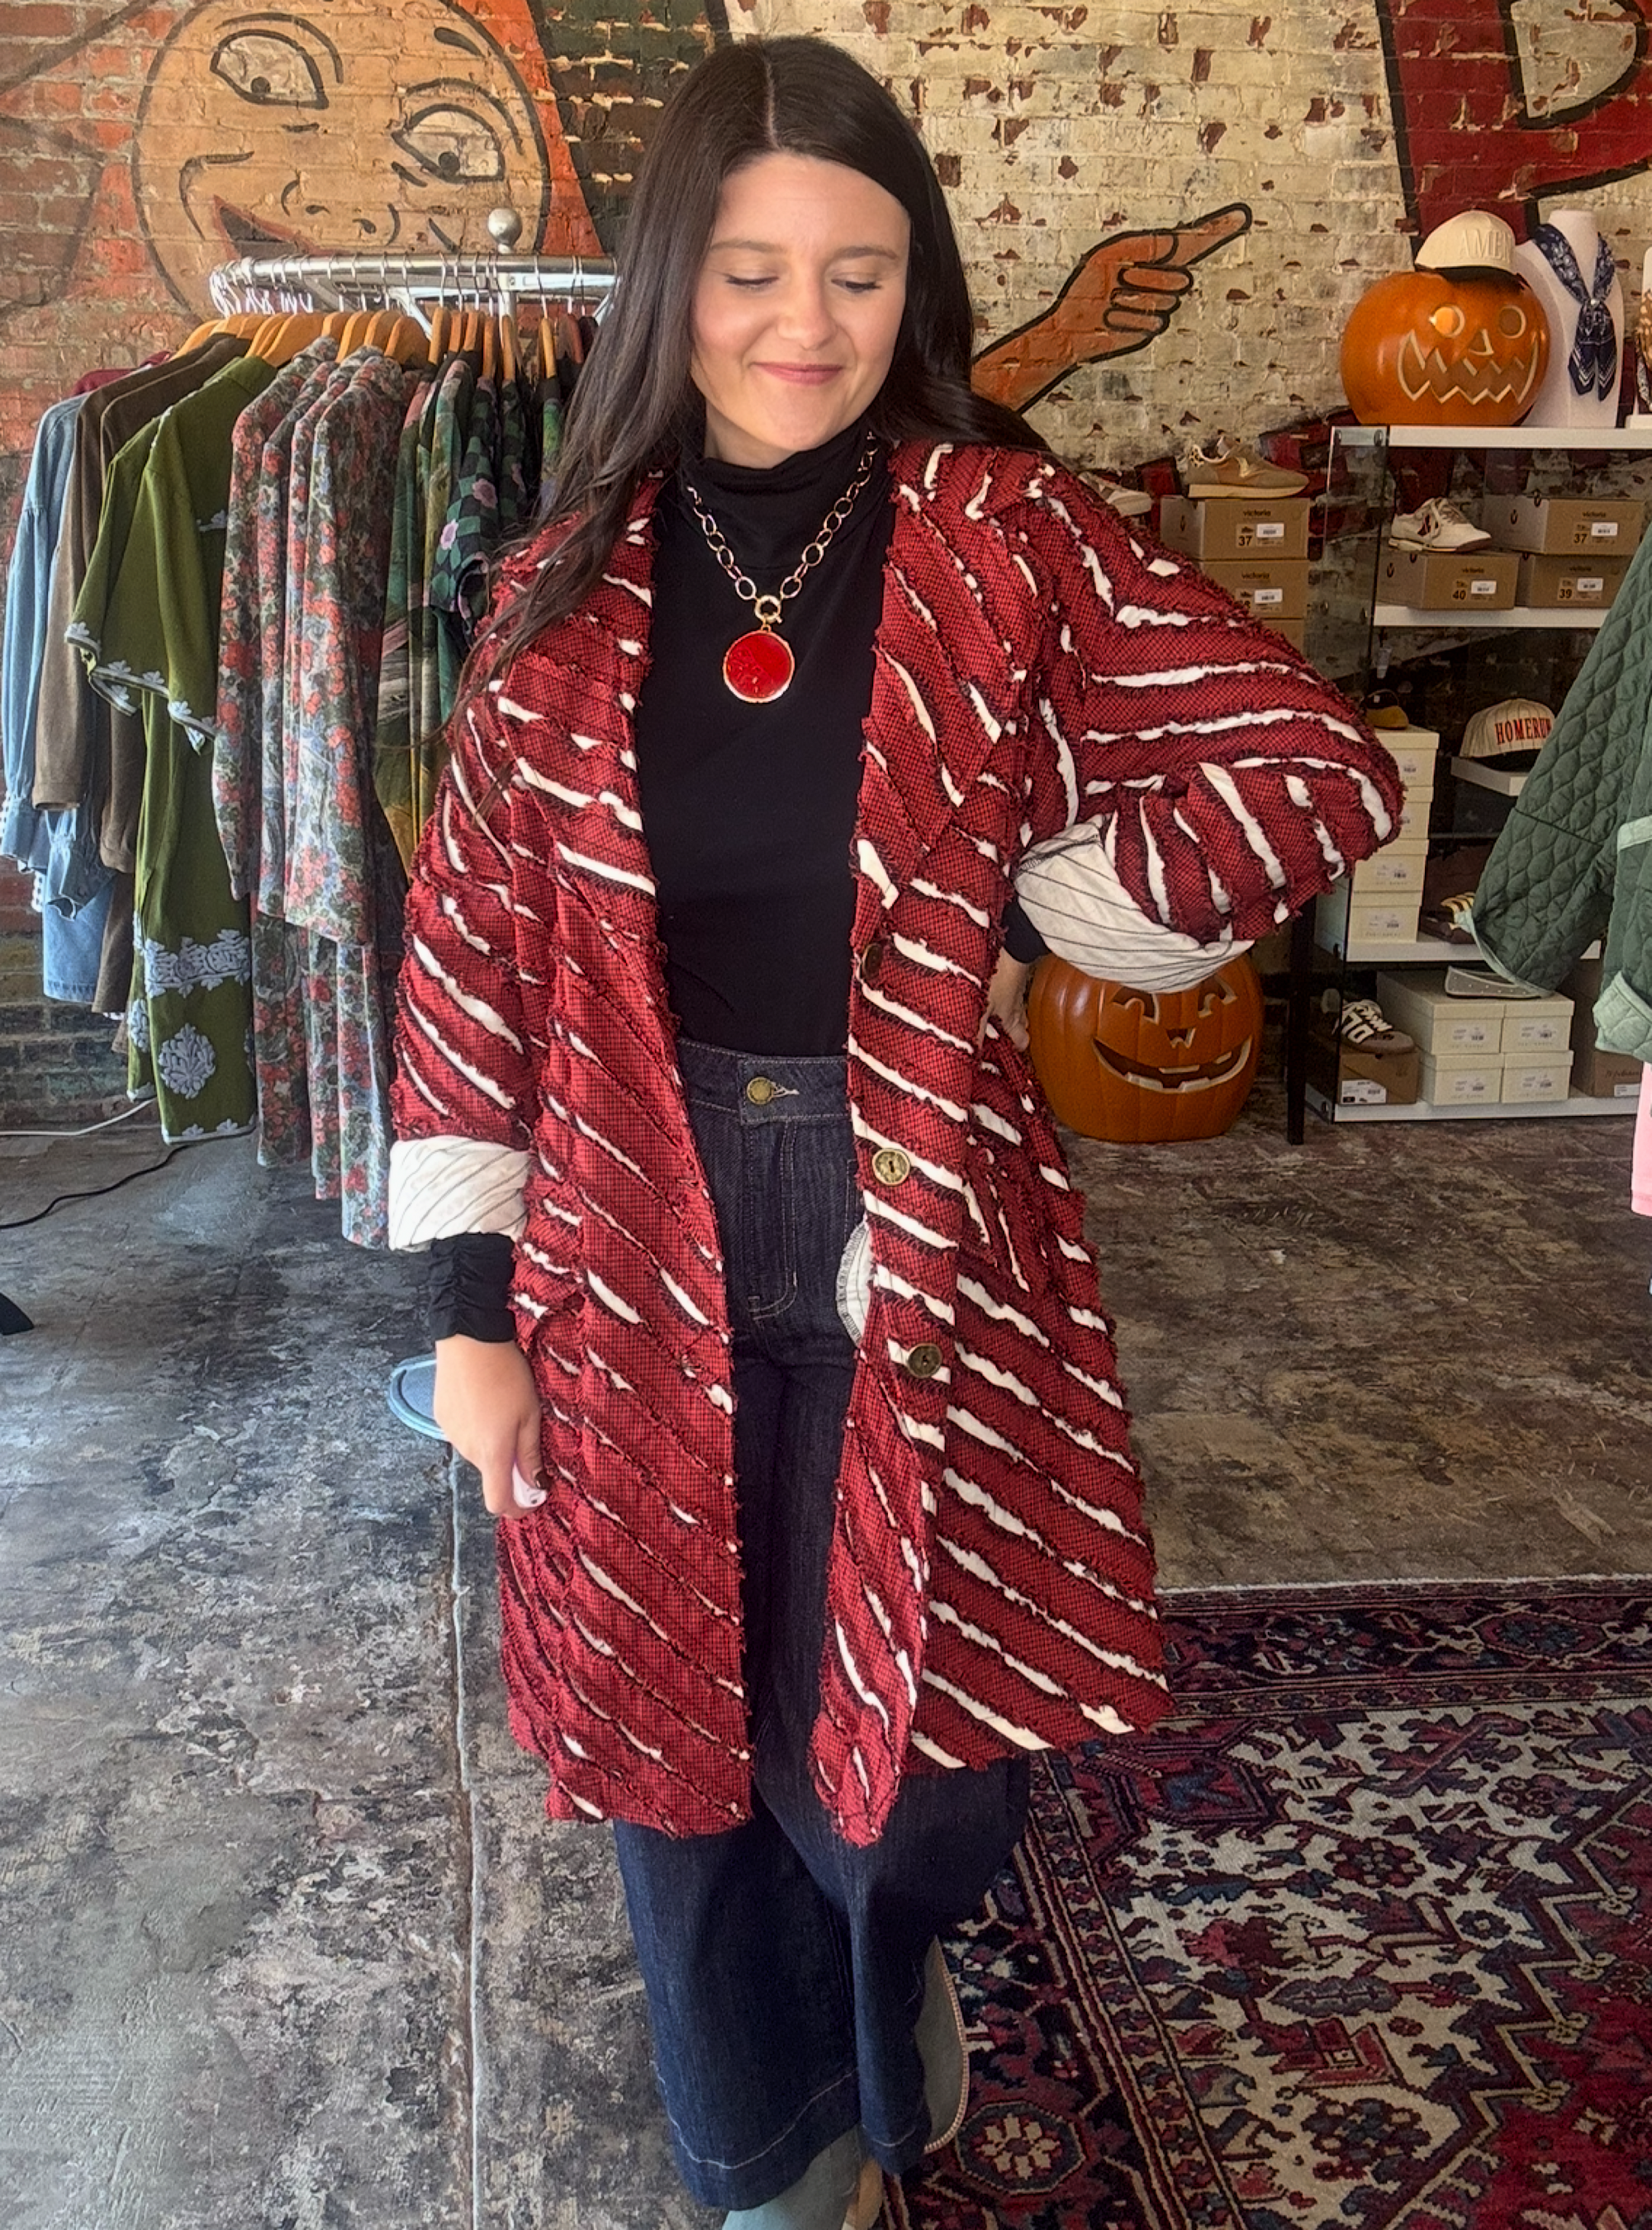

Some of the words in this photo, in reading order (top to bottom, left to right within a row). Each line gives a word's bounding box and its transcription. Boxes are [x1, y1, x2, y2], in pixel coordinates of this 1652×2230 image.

[1238, 534, 1253, 547] 37
[1574, 533, 1588, 544] 37
[1452, 590, 1466, 600] 40
[1559, 588, 1573, 599] 39
